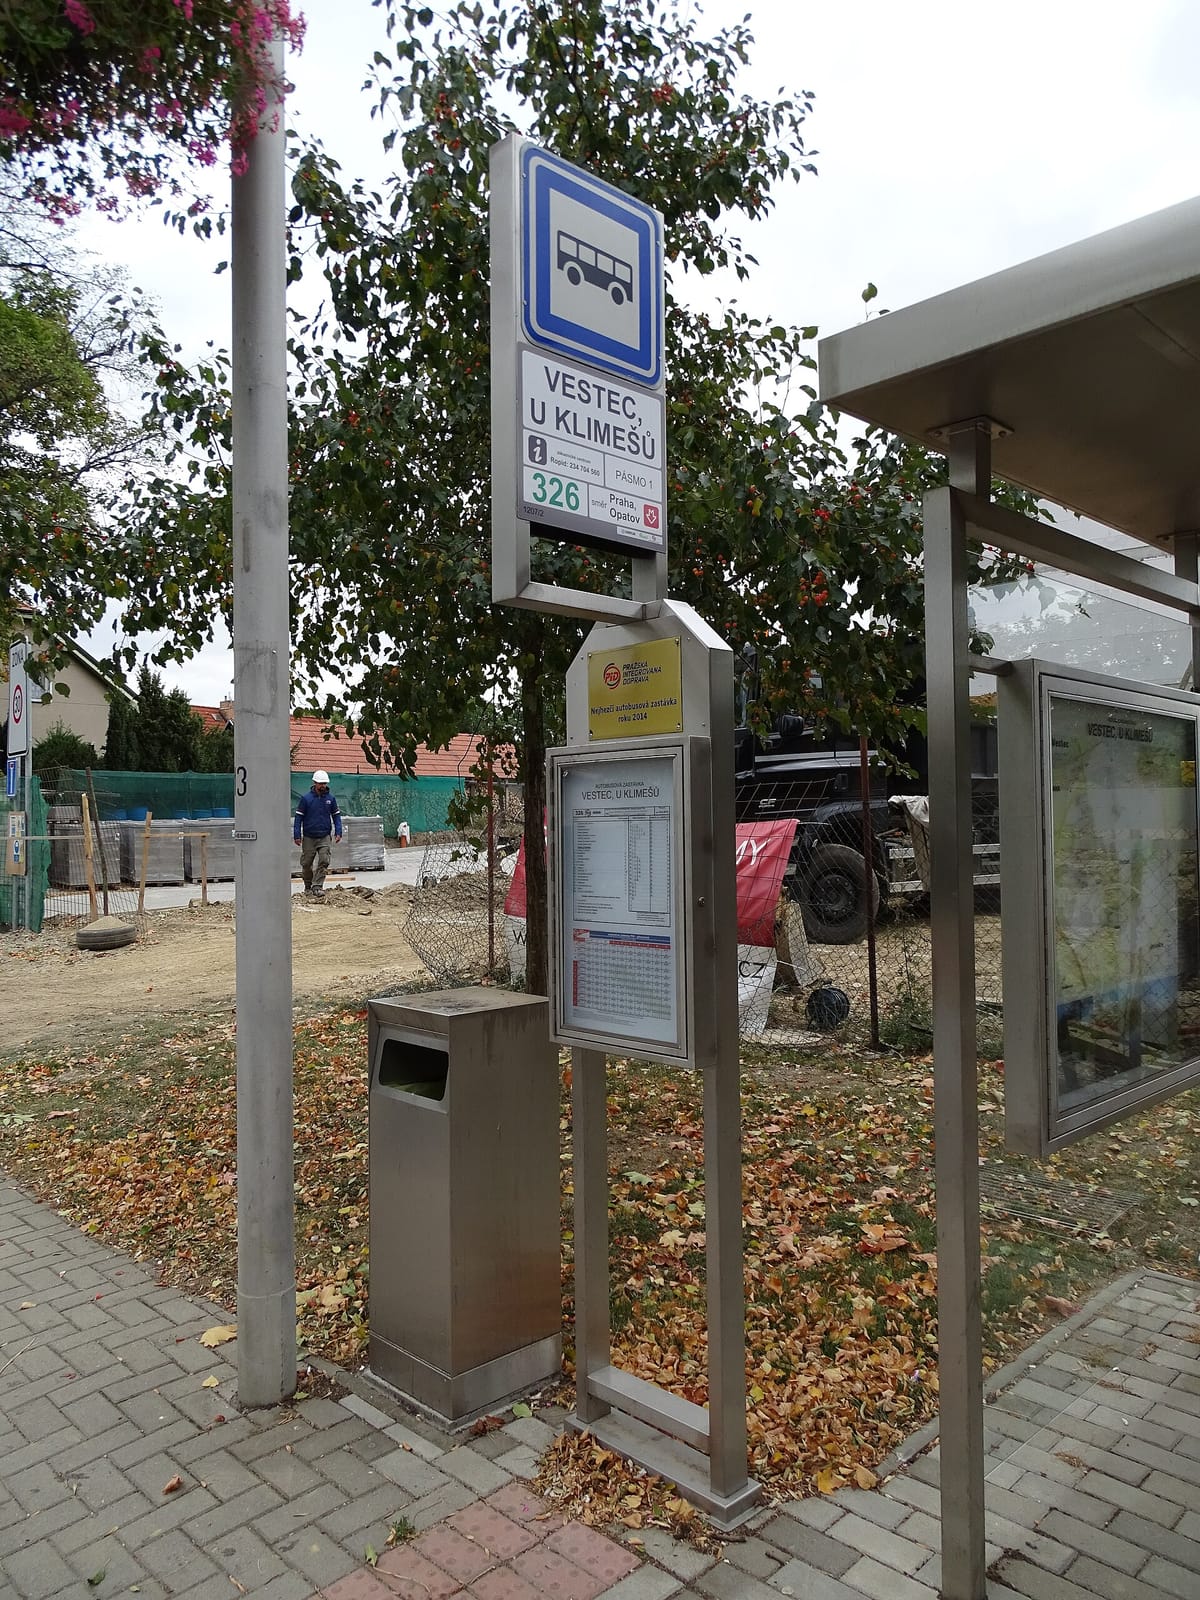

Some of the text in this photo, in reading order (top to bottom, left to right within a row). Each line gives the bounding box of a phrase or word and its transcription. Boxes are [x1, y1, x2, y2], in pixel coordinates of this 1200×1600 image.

[544, 365, 642, 427] VESTEC,
[530, 398, 655, 460] U KLIMEŠŮ
[615, 469, 647, 487] PÁSMO
[532, 472, 580, 511] 326
[609, 493, 637, 511] Praha,
[609, 507, 641, 524] Opatov
[650, 697, 678, 708] zastávka
[618, 712, 648, 723] roku 2014
[236, 766, 247, 797] 3
[581, 786, 660, 800] VESTEC, U KLIMEŠŮ
